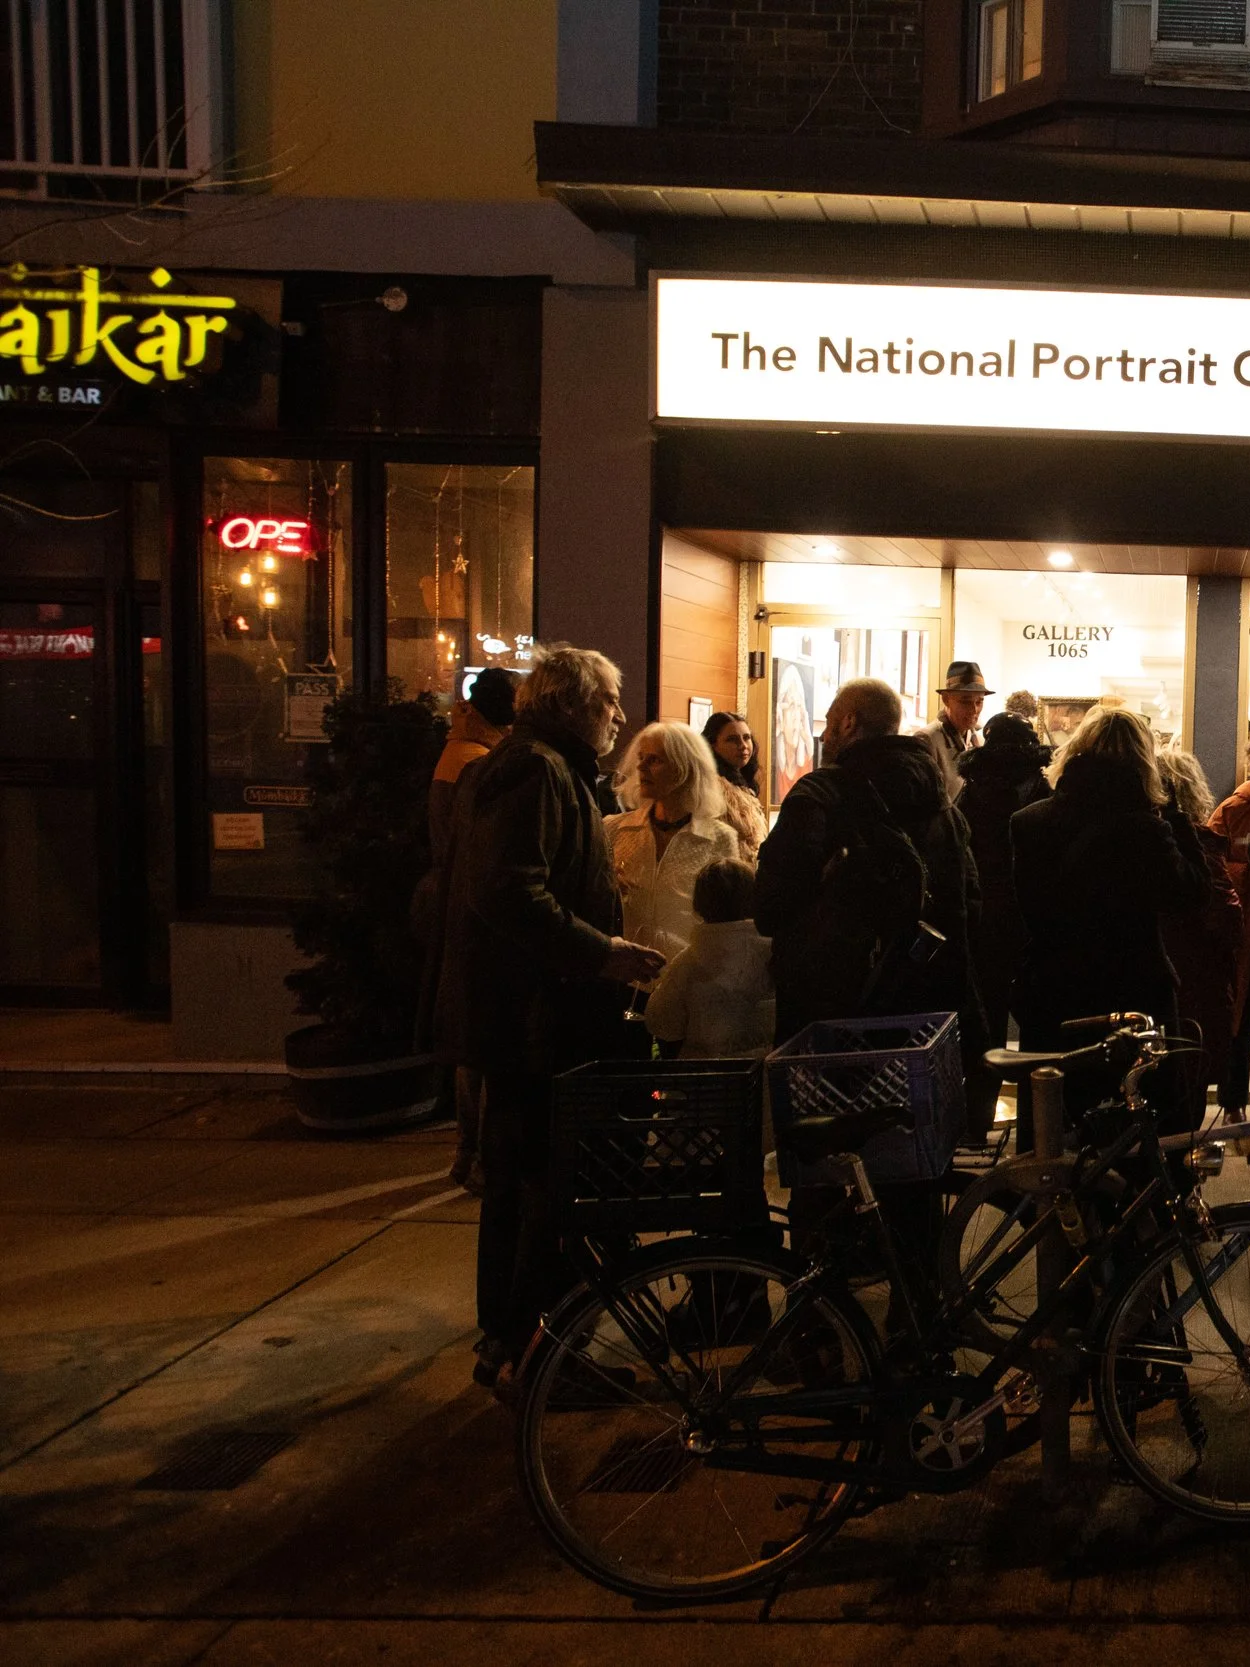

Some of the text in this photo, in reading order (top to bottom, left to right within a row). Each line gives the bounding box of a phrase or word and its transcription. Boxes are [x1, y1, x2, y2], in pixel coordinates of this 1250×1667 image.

[712, 332, 797, 371] The
[818, 336, 1016, 378] National
[1032, 343, 1218, 386] Portrait
[37, 385, 53, 403] &
[57, 386, 101, 405] BAR
[1022, 624, 1114, 641] GALLERY
[1048, 643, 1088, 658] 1065
[295, 682, 330, 695] PASS
